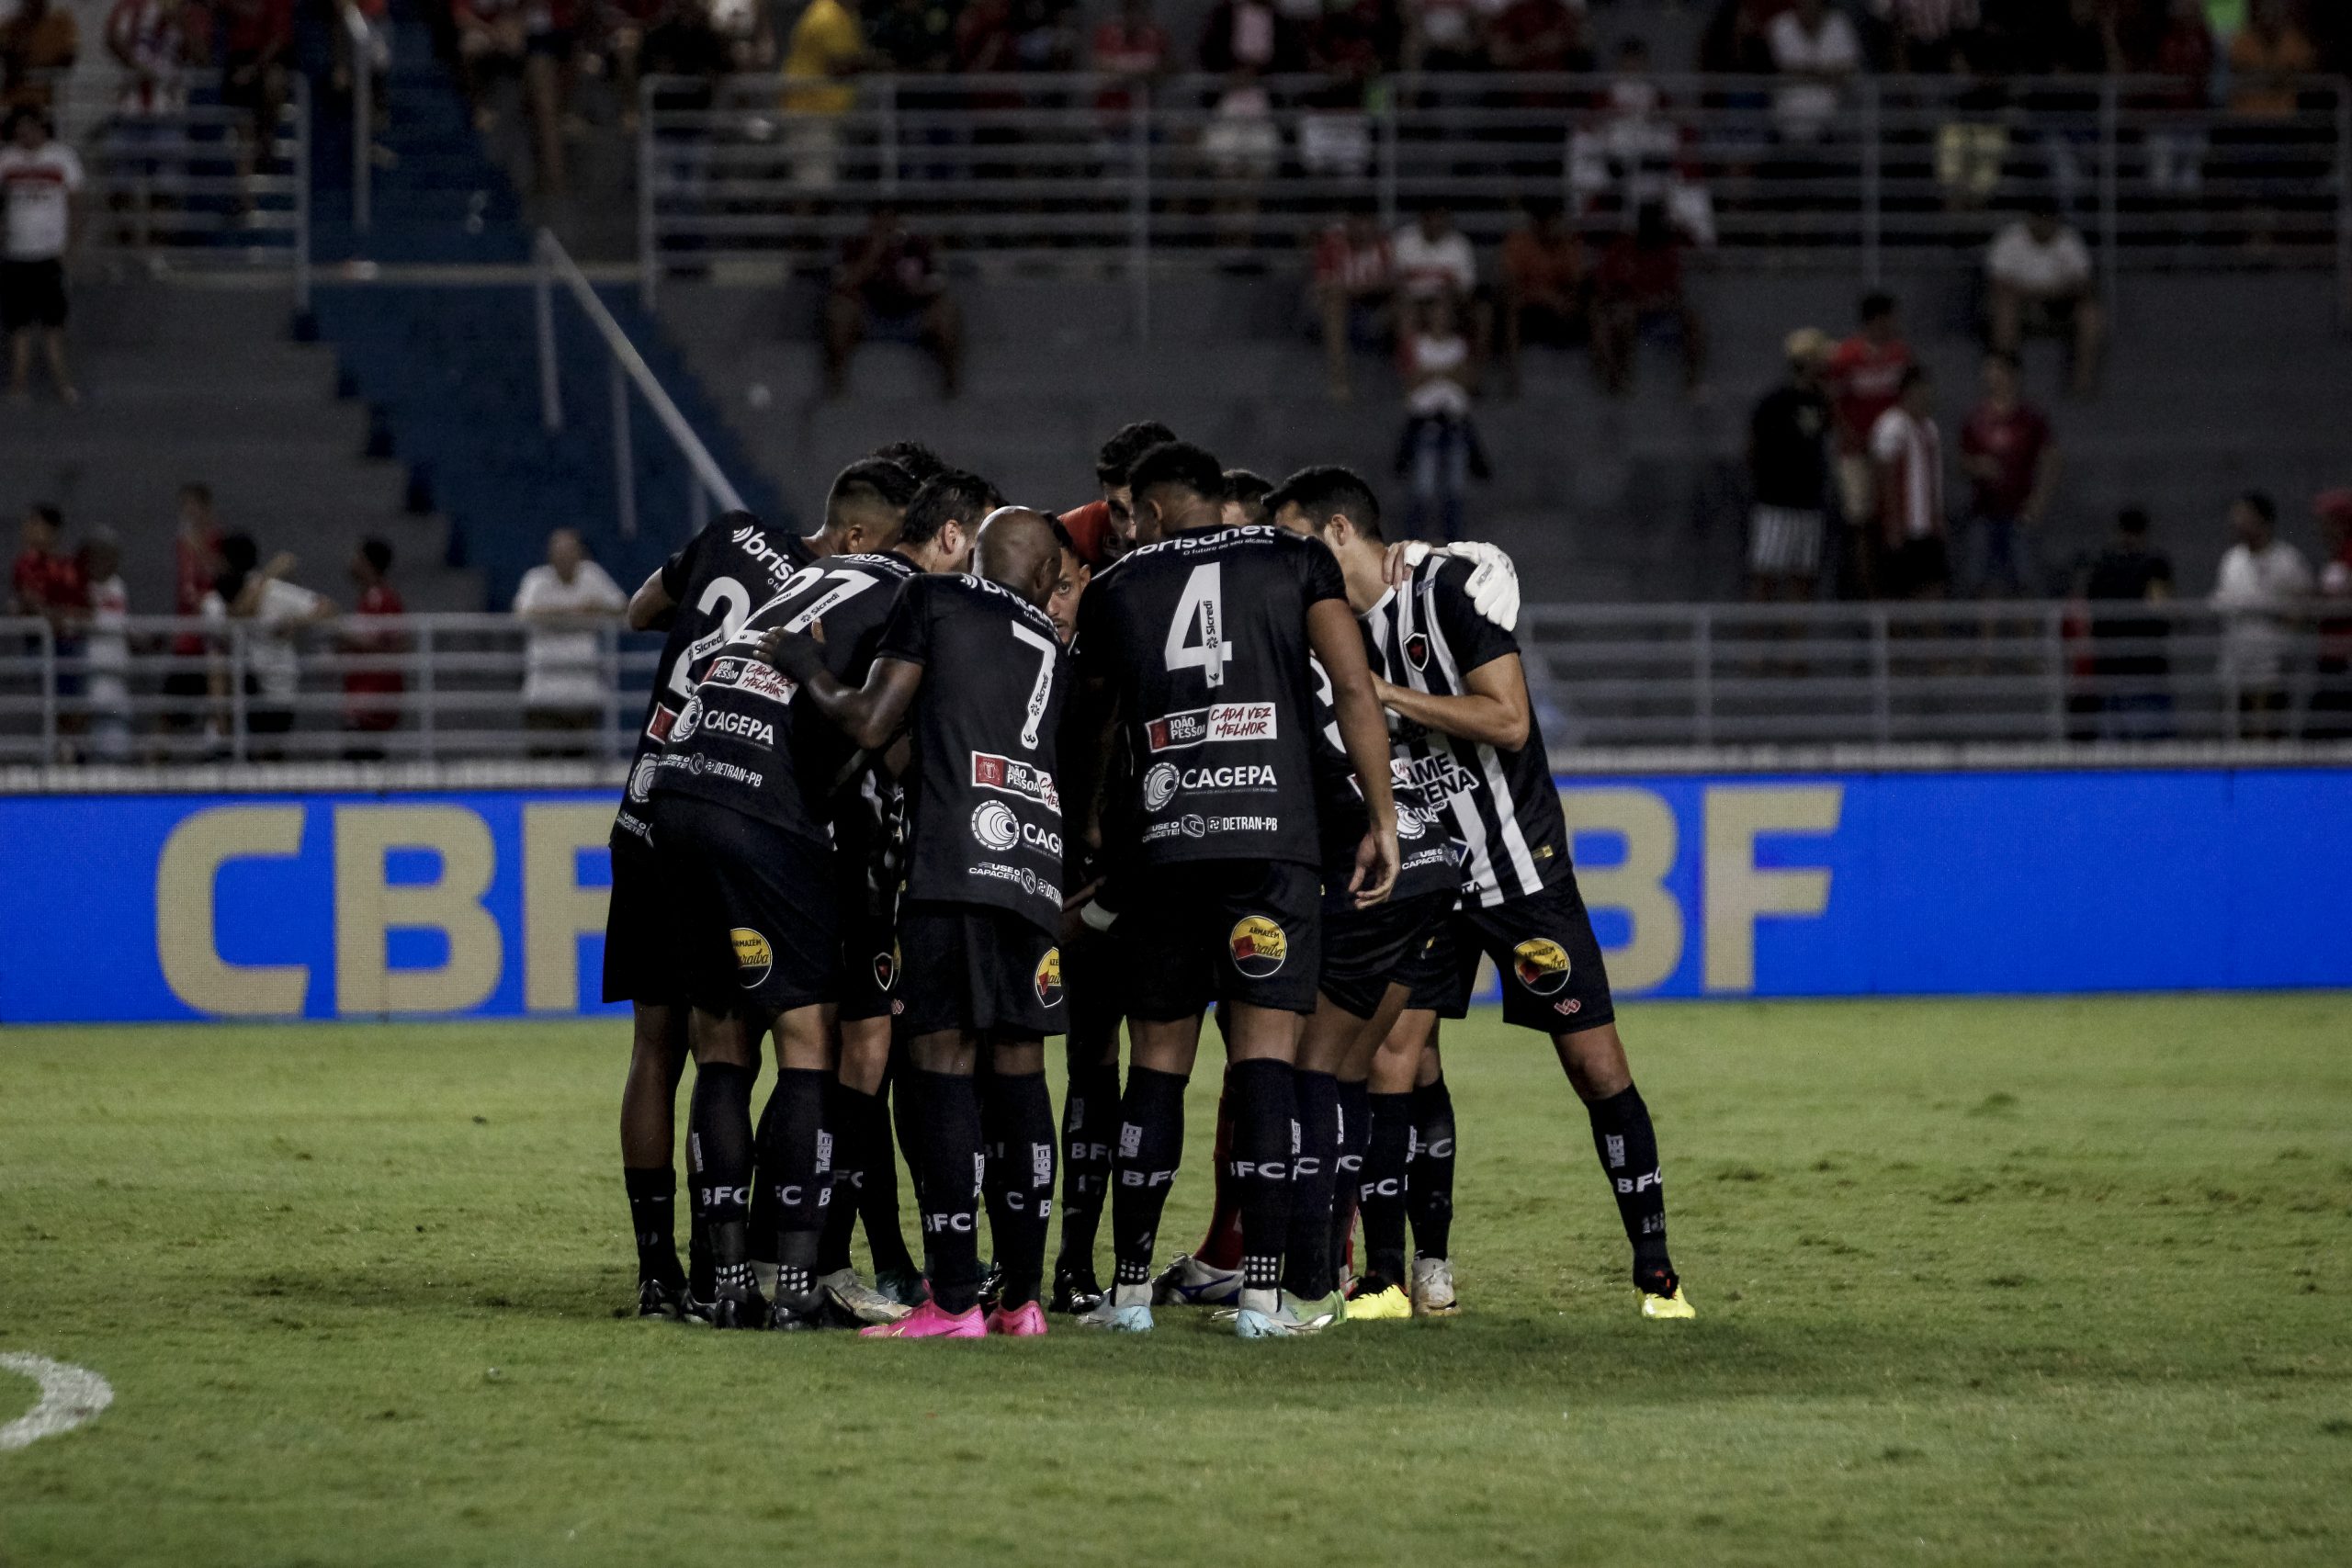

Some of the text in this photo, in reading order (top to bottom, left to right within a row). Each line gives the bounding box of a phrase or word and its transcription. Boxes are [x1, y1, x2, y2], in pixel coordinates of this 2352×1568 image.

[741, 530, 797, 581] bris
[725, 567, 880, 646] 27
[811, 592, 840, 615] Sicredi
[1206, 600, 1215, 635] Sicredi
[668, 576, 751, 700] 2
[1164, 561, 1233, 689] 4
[1012, 619, 1057, 750] 7
[1035, 674, 1049, 706] Sicredi
[704, 709, 774, 745] CAGEPA
[1170, 716, 1195, 731] JOÃO
[1210, 706, 1272, 722] CADA VEZ
[1216, 720, 1268, 738] MELHOR
[714, 761, 763, 787] DETRAN-PB
[1007, 763, 1027, 779] JOÃO
[1007, 773, 1040, 794] PESSOA
[1182, 764, 1277, 789] CAGEPA
[1223, 816, 1278, 831] DETRAN-PB
[991, 863, 1014, 874] USE
[155, 802, 627, 1019] CBF
[816, 1129, 833, 1175] TVBET
[1032, 1142, 1051, 1189] TVBET
